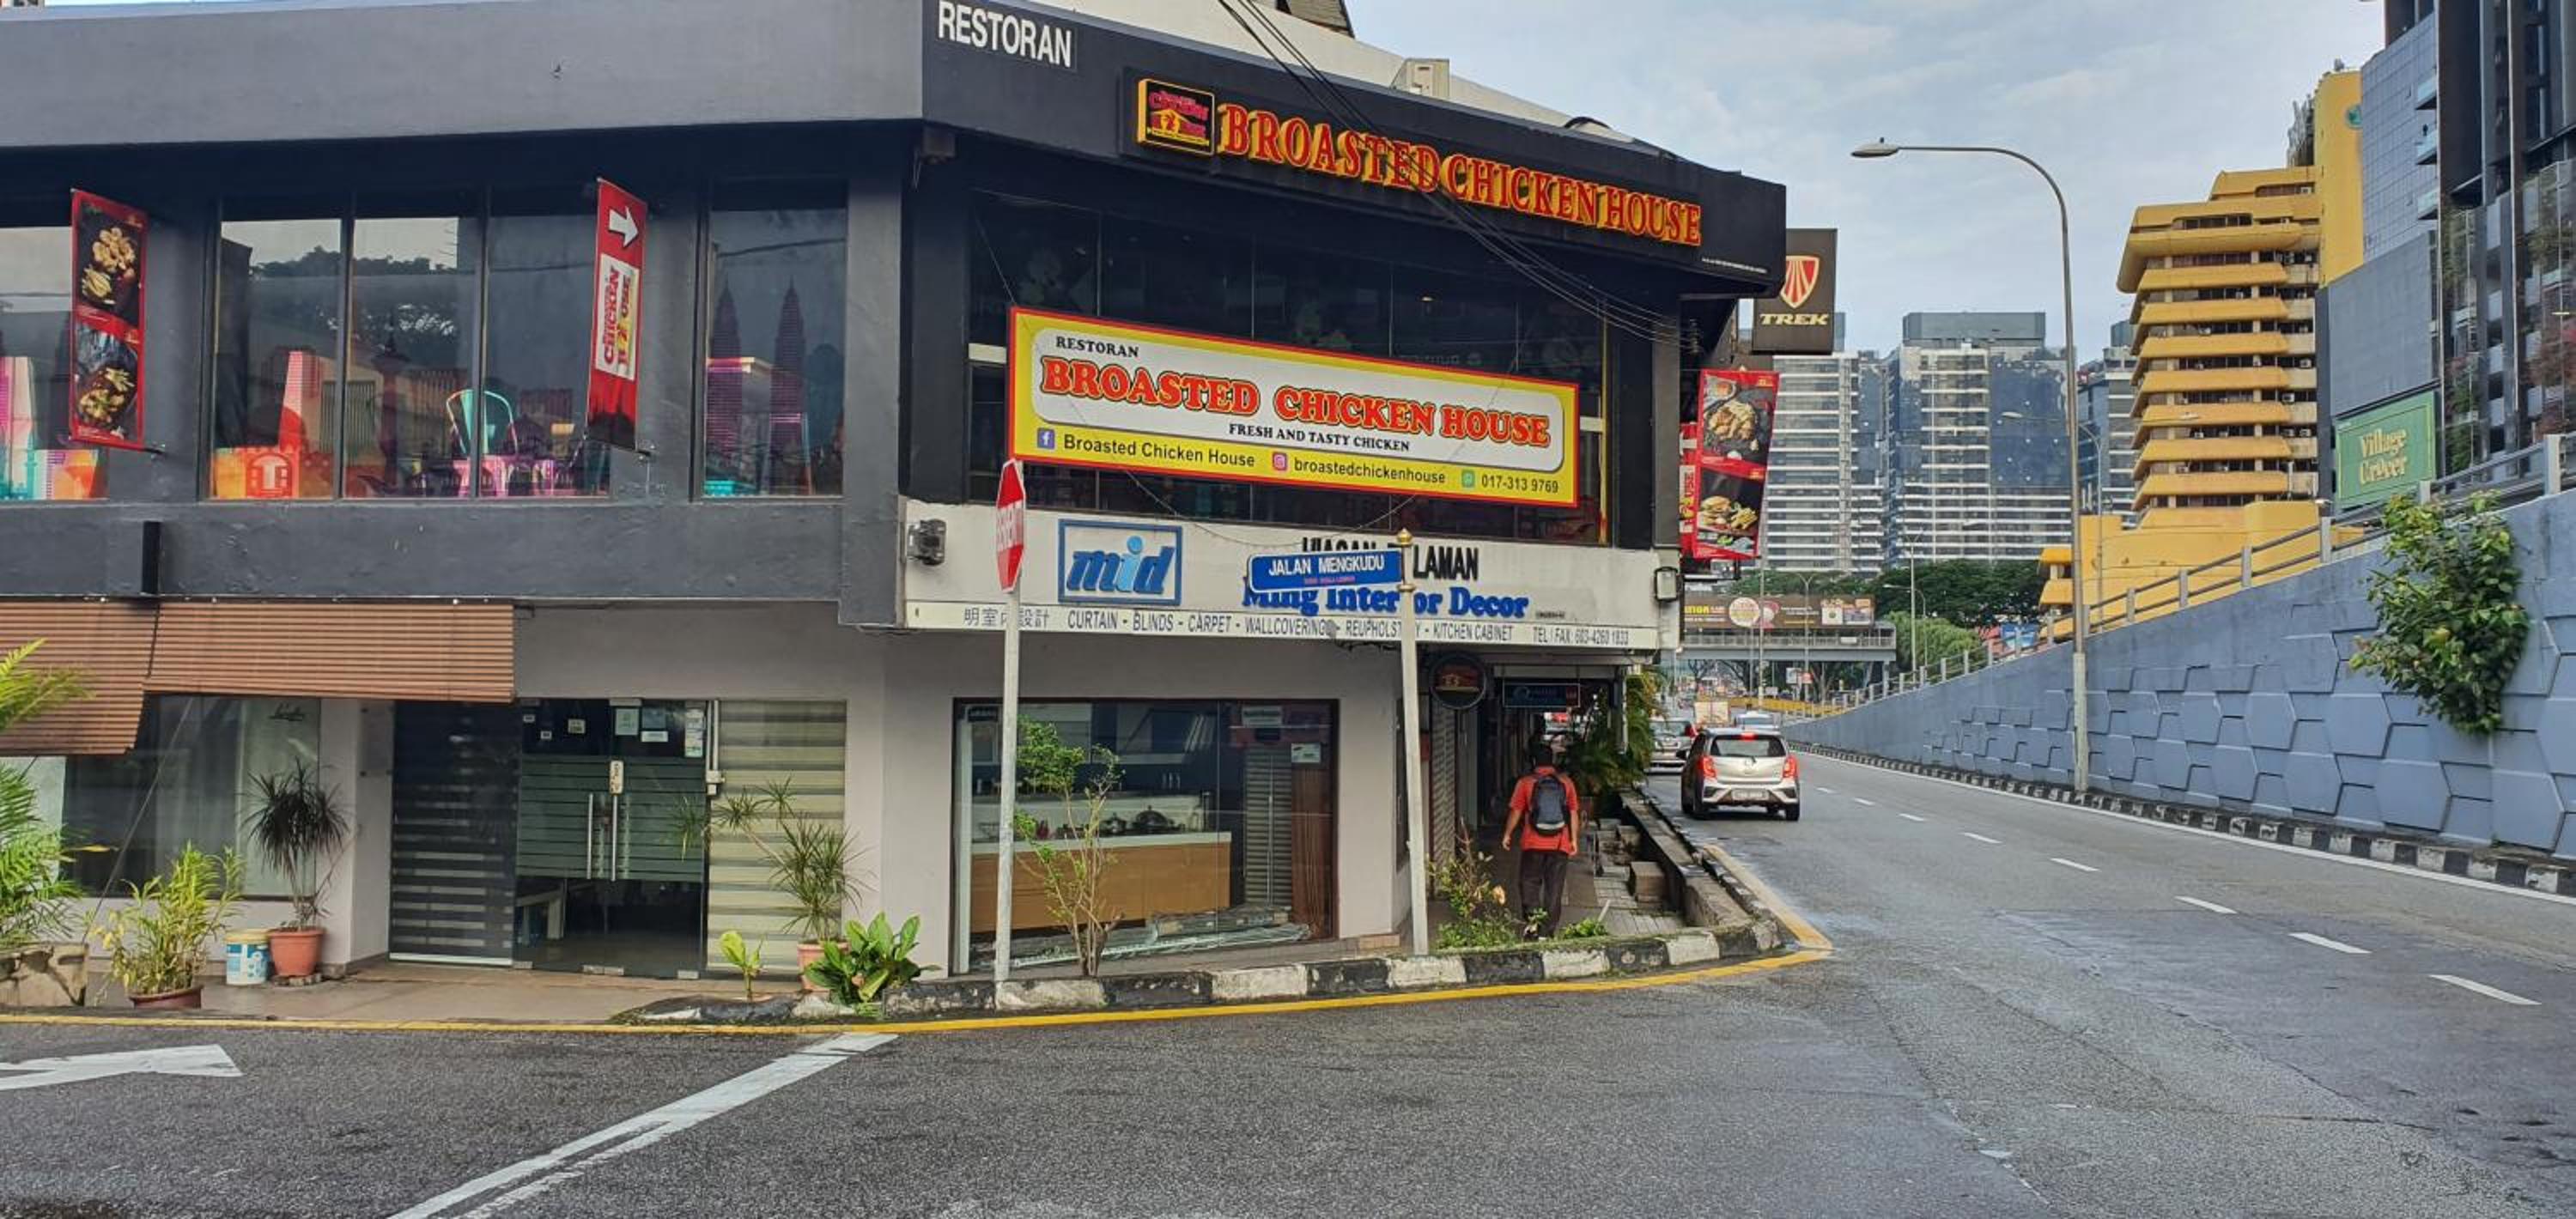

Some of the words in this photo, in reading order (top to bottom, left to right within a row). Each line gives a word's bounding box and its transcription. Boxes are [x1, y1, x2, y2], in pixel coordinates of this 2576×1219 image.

[938, 3, 1072, 68] RESTORAN
[1218, 103, 1440, 193] BROASTED
[1442, 154, 1598, 227] CHICKEN
[1598, 184, 1702, 246] HOUSE
[1760, 313, 1829, 325] TREK
[1056, 336, 1139, 358] RESTORAN
[1041, 355, 1261, 417] BROASTED
[1273, 385, 1436, 436] CHICKEN
[1440, 403, 1551, 447] HOUSE
[1064, 434, 1136, 456] Broasted
[1141, 442, 1203, 462] Chicken
[1208, 446, 1255, 467] House
[1229, 423, 1273, 440] FRESH
[1276, 428, 1305, 443] AND
[1308, 431, 1350, 448] TASTY
[1352, 435, 1410, 452] CHICKEN
[1294, 458, 1445, 484] broastedchickenhouse
[1481, 474, 1528, 492] 017-313
[1530, 476, 1559, 494] 9769
[1066, 535, 1176, 595] mid
[1268, 559, 1311, 576] JALAN
[1318, 554, 1385, 573] MENGKUDU
[1388, 543, 1479, 581] LAMAN
[1326, 587, 1443, 616] Interor
[1449, 586, 1529, 618] Decor
[1067, 610, 1117, 629] CURTAIN
[1133, 612, 1174, 632] BLINDS
[1188, 614, 1232, 634] CARPET
[1433, 623, 1473, 640] KITCHEN
[1475, 624, 1513, 641] CABINET
[1534, 626, 1548, 643] TEL
